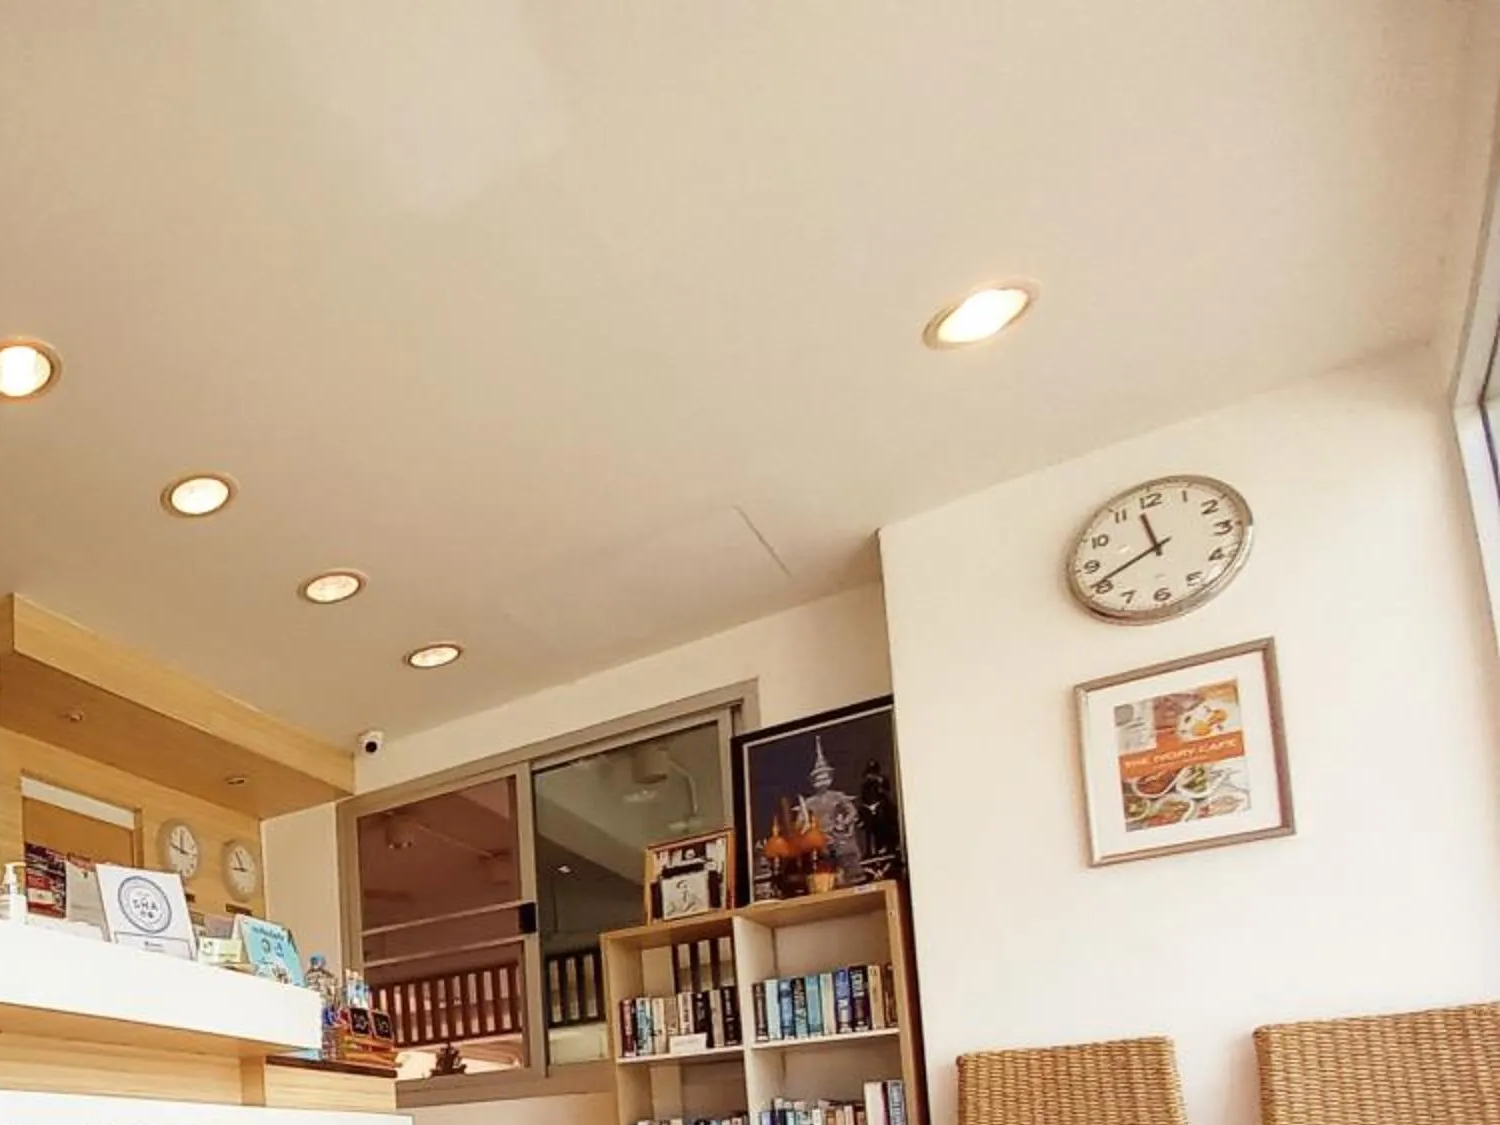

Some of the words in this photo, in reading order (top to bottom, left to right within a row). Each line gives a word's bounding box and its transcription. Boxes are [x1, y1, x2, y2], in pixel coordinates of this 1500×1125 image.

[1139, 492, 1163, 510] 12
[1181, 490, 1188, 502] 1
[1201, 499, 1219, 515] 2
[1114, 509, 1127, 524] 11
[1214, 520, 1233, 536] 3
[1091, 534, 1109, 549] 10
[1208, 547, 1224, 561] 4
[1083, 560, 1100, 574] 9
[1093, 579, 1114, 594] 8
[1186, 571, 1203, 587] 5
[1121, 590, 1137, 604] 7
[1153, 587, 1172, 602] 6
